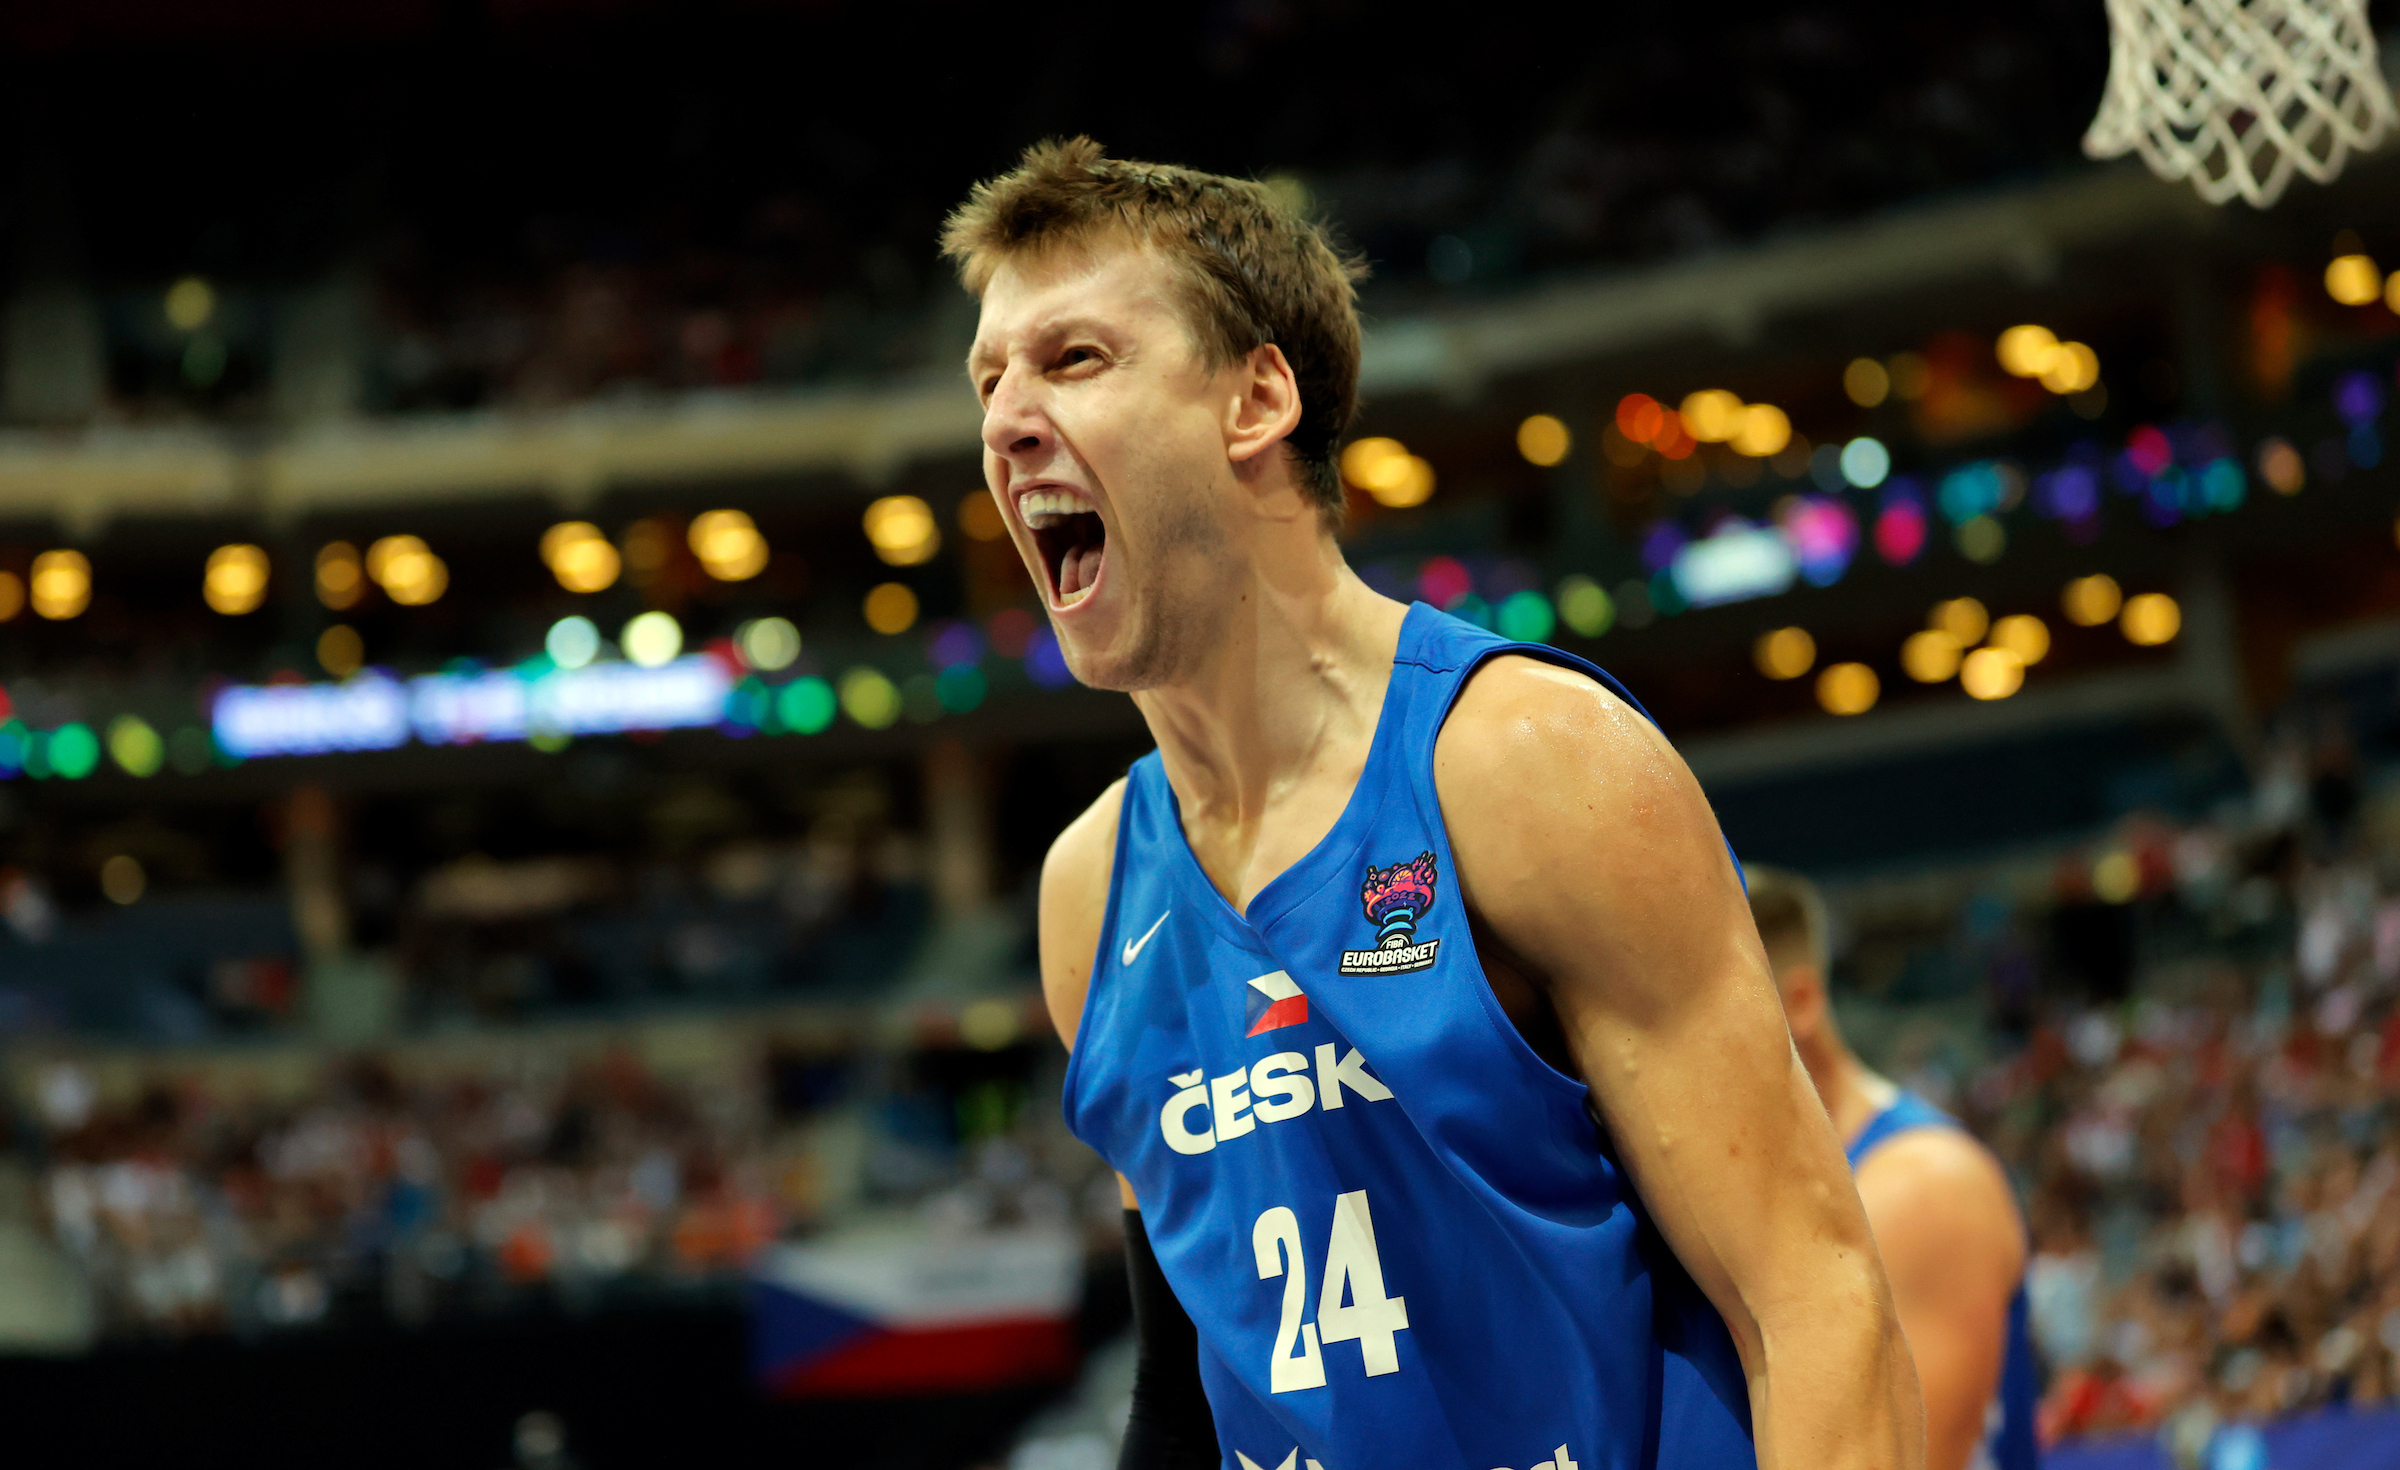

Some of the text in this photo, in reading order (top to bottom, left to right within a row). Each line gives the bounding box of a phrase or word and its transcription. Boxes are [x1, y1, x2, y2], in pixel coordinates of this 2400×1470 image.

[1385, 892, 1416, 905] 2022
[1343, 941, 1438, 966] EUROBASKET
[1386, 939, 1404, 949] FIBA
[1252, 1189, 1409, 1394] 24
